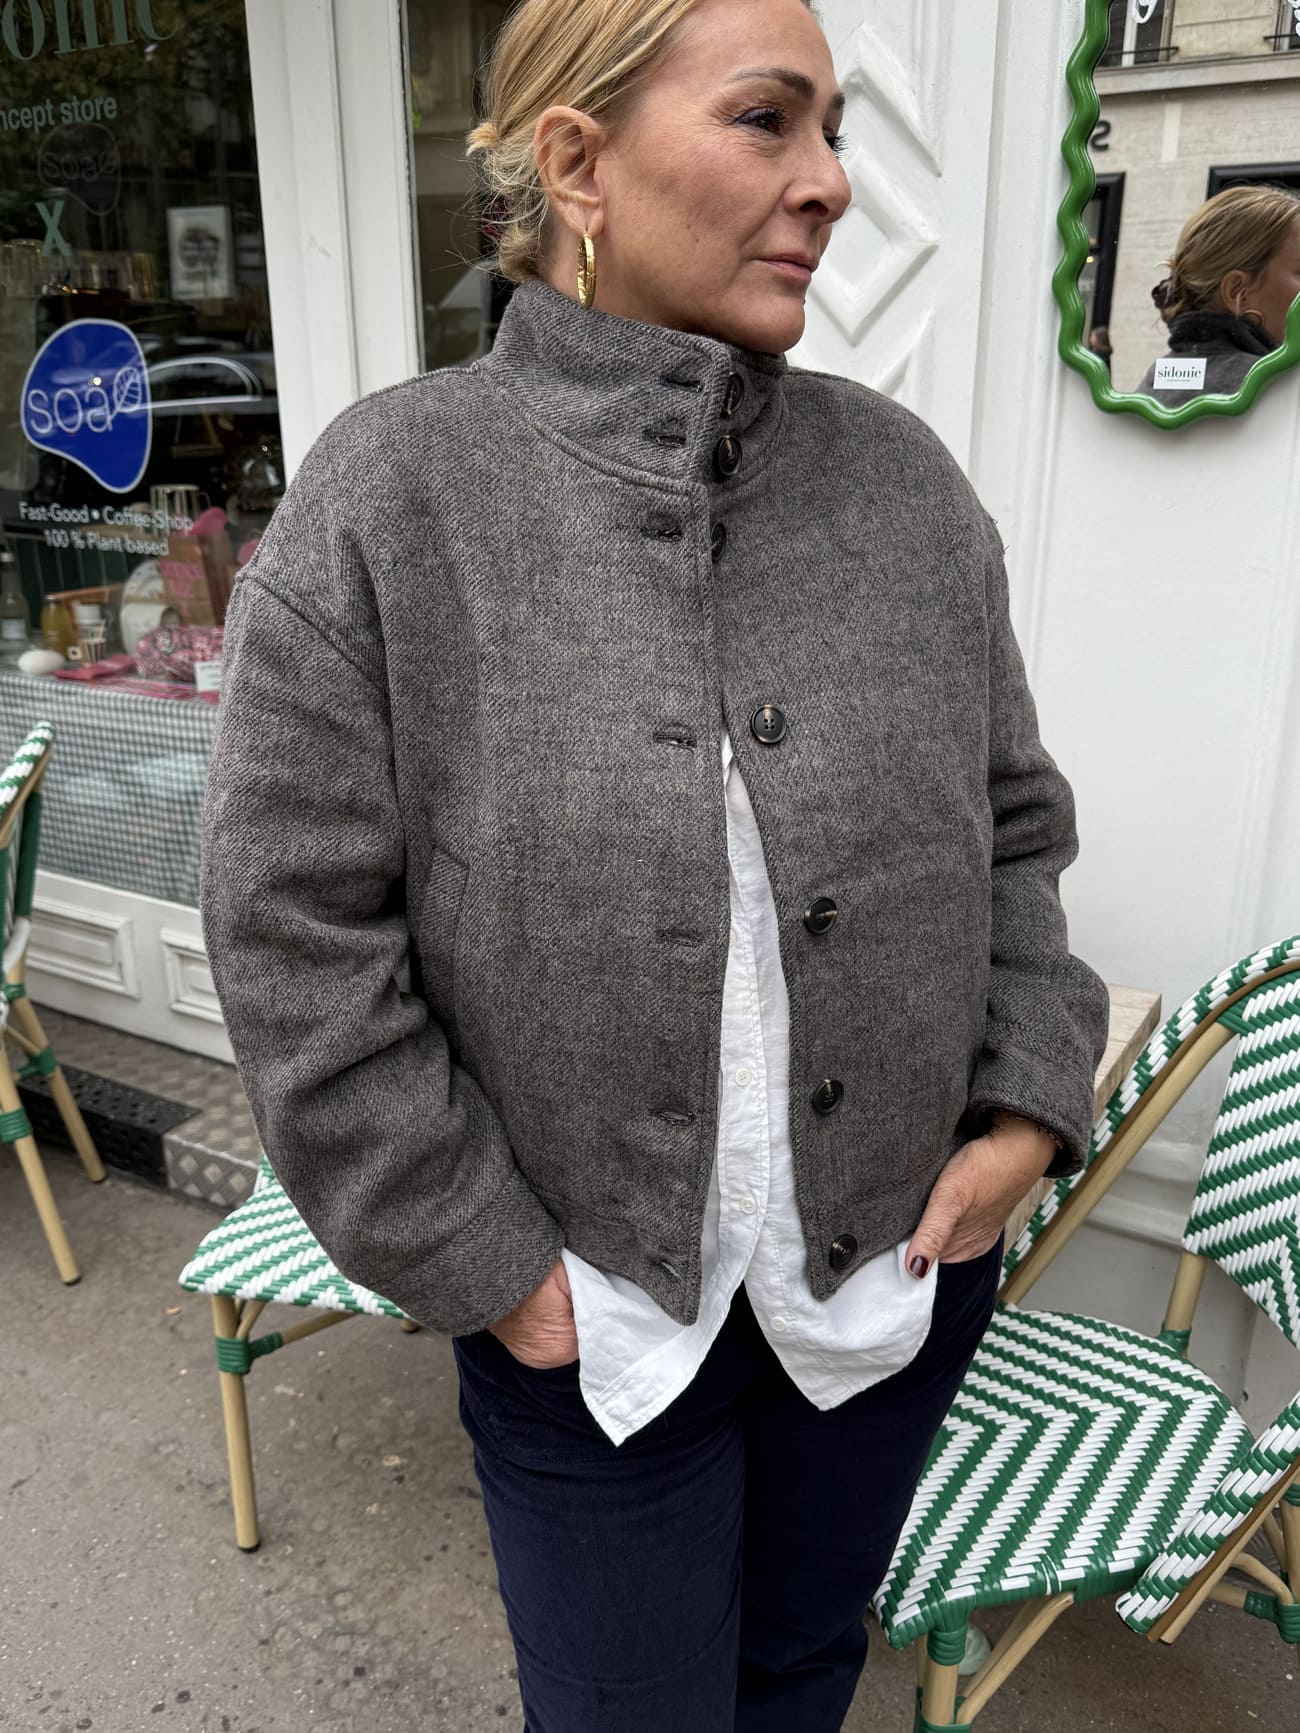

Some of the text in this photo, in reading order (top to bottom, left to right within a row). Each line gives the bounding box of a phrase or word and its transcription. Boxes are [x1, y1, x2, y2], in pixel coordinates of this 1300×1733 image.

[60, 96, 118, 124] store
[1158, 366, 1201, 378] sidonie
[18, 502, 193, 534] Fast-Good Coffee-Shop
[44, 528, 69, 548] 100
[87, 531, 122, 552] Plant
[125, 534, 169, 556] based
